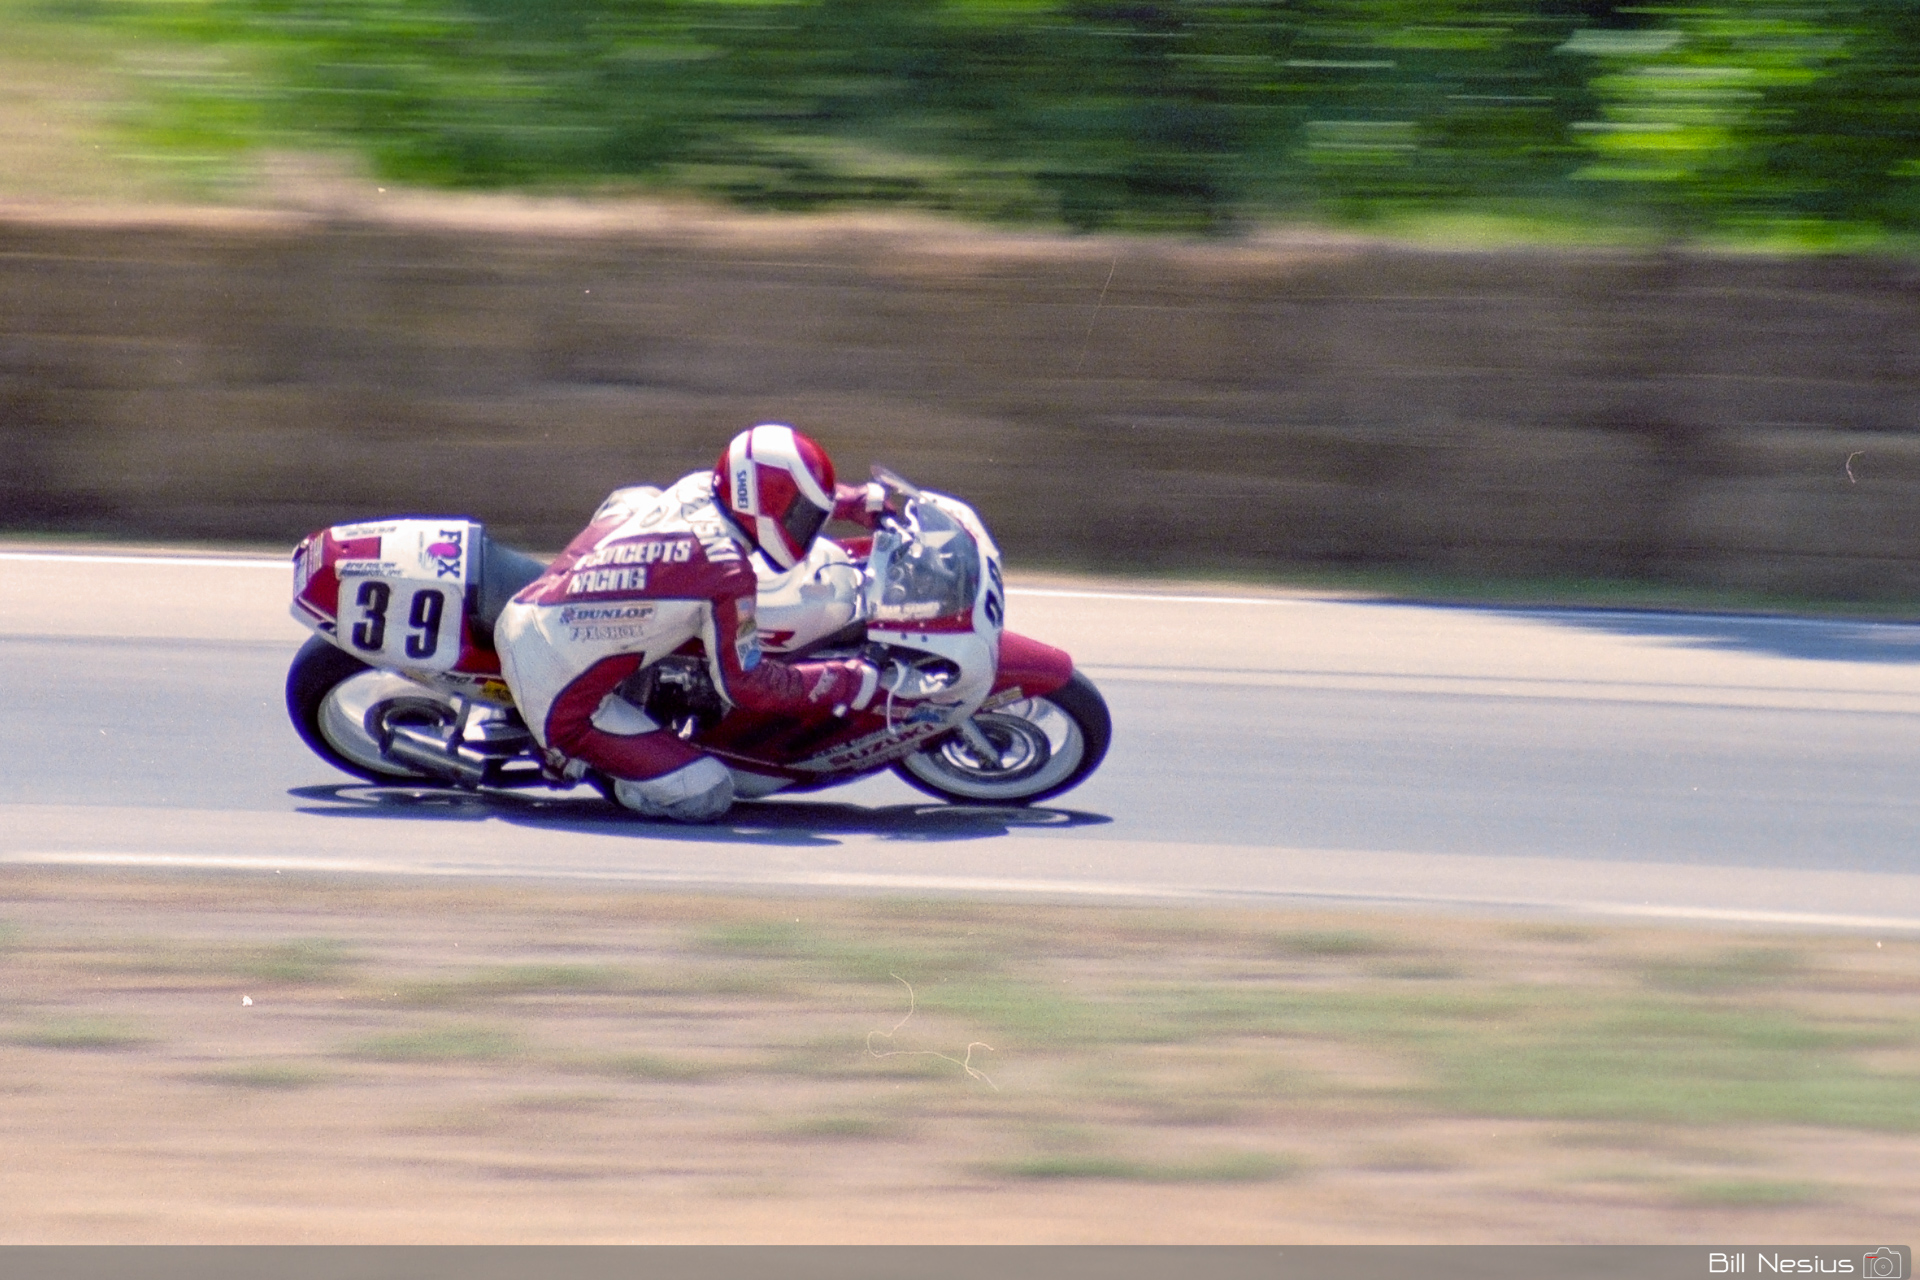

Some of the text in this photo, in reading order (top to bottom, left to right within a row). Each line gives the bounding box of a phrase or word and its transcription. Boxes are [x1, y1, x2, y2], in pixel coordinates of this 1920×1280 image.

[736, 469, 749, 509] SHOEI
[352, 580, 445, 659] 39
[577, 607, 653, 620] DUNLOP
[827, 722, 935, 769] SUZUKI
